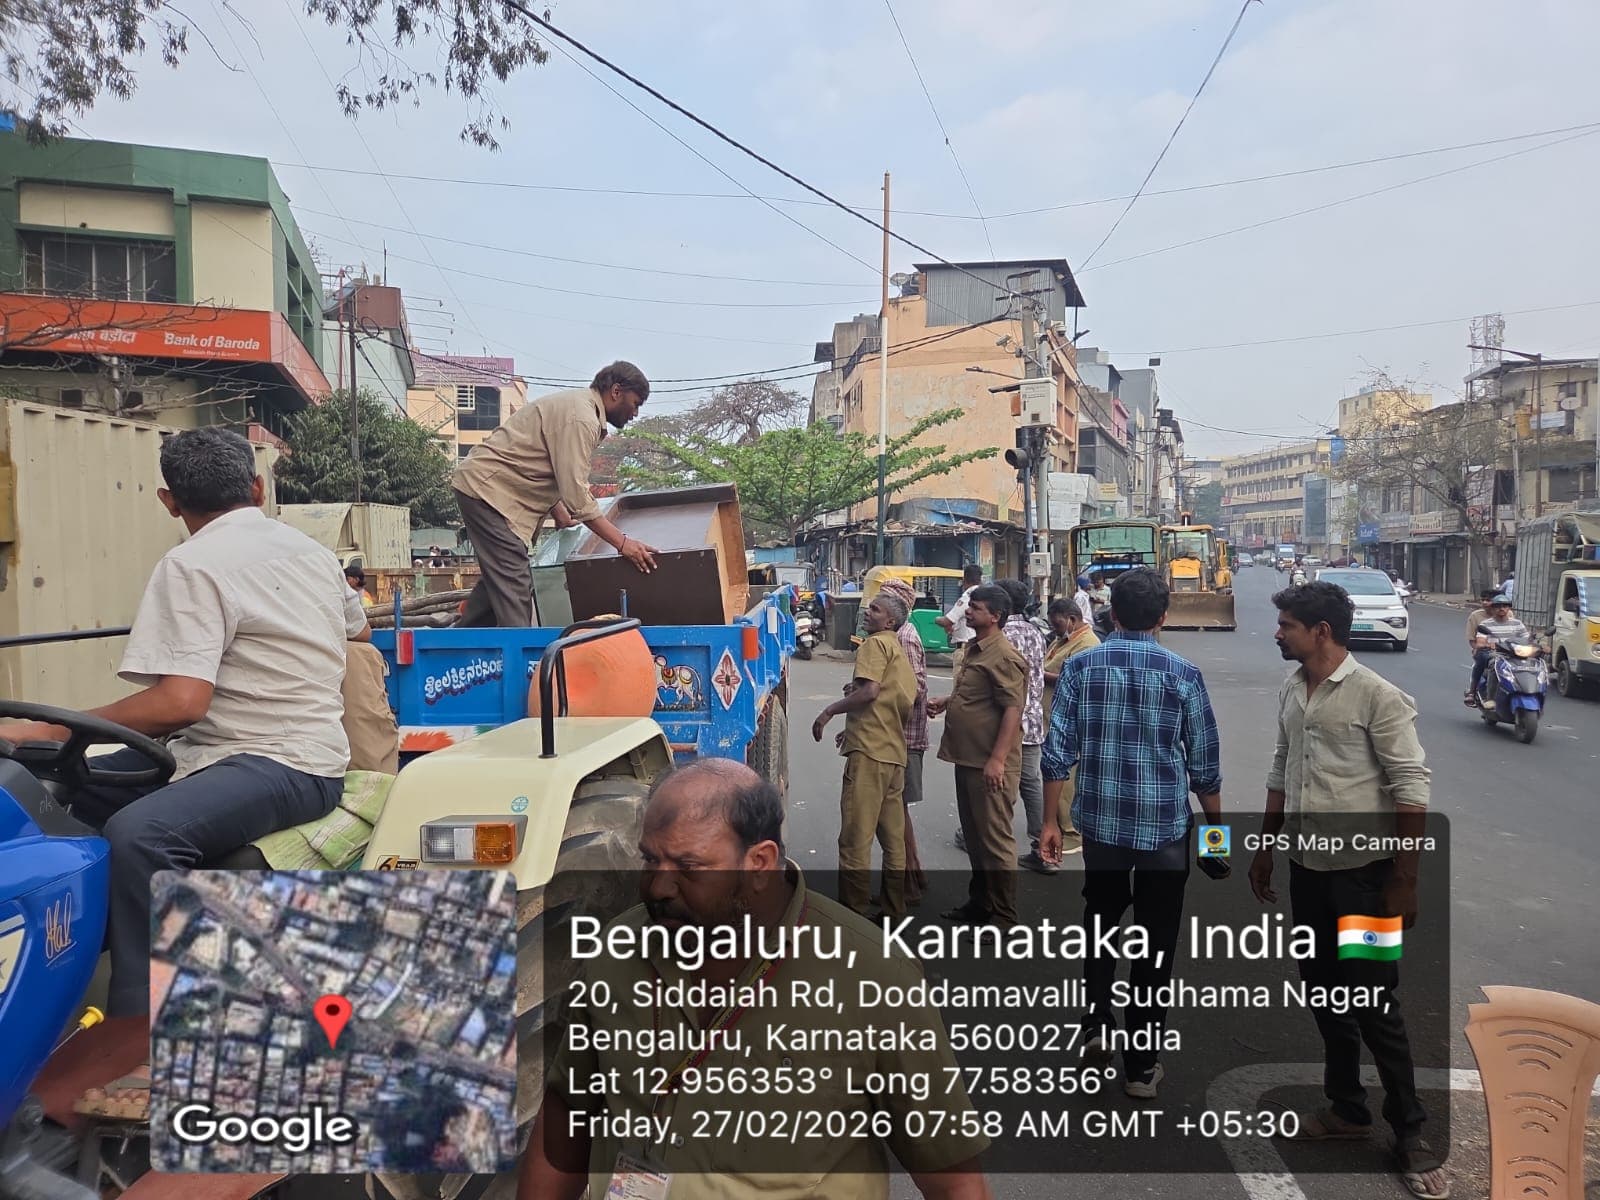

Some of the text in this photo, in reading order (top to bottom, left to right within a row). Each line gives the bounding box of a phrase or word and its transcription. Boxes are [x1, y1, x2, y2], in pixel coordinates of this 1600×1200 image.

[164, 331, 260, 351] Bank of Baroda
